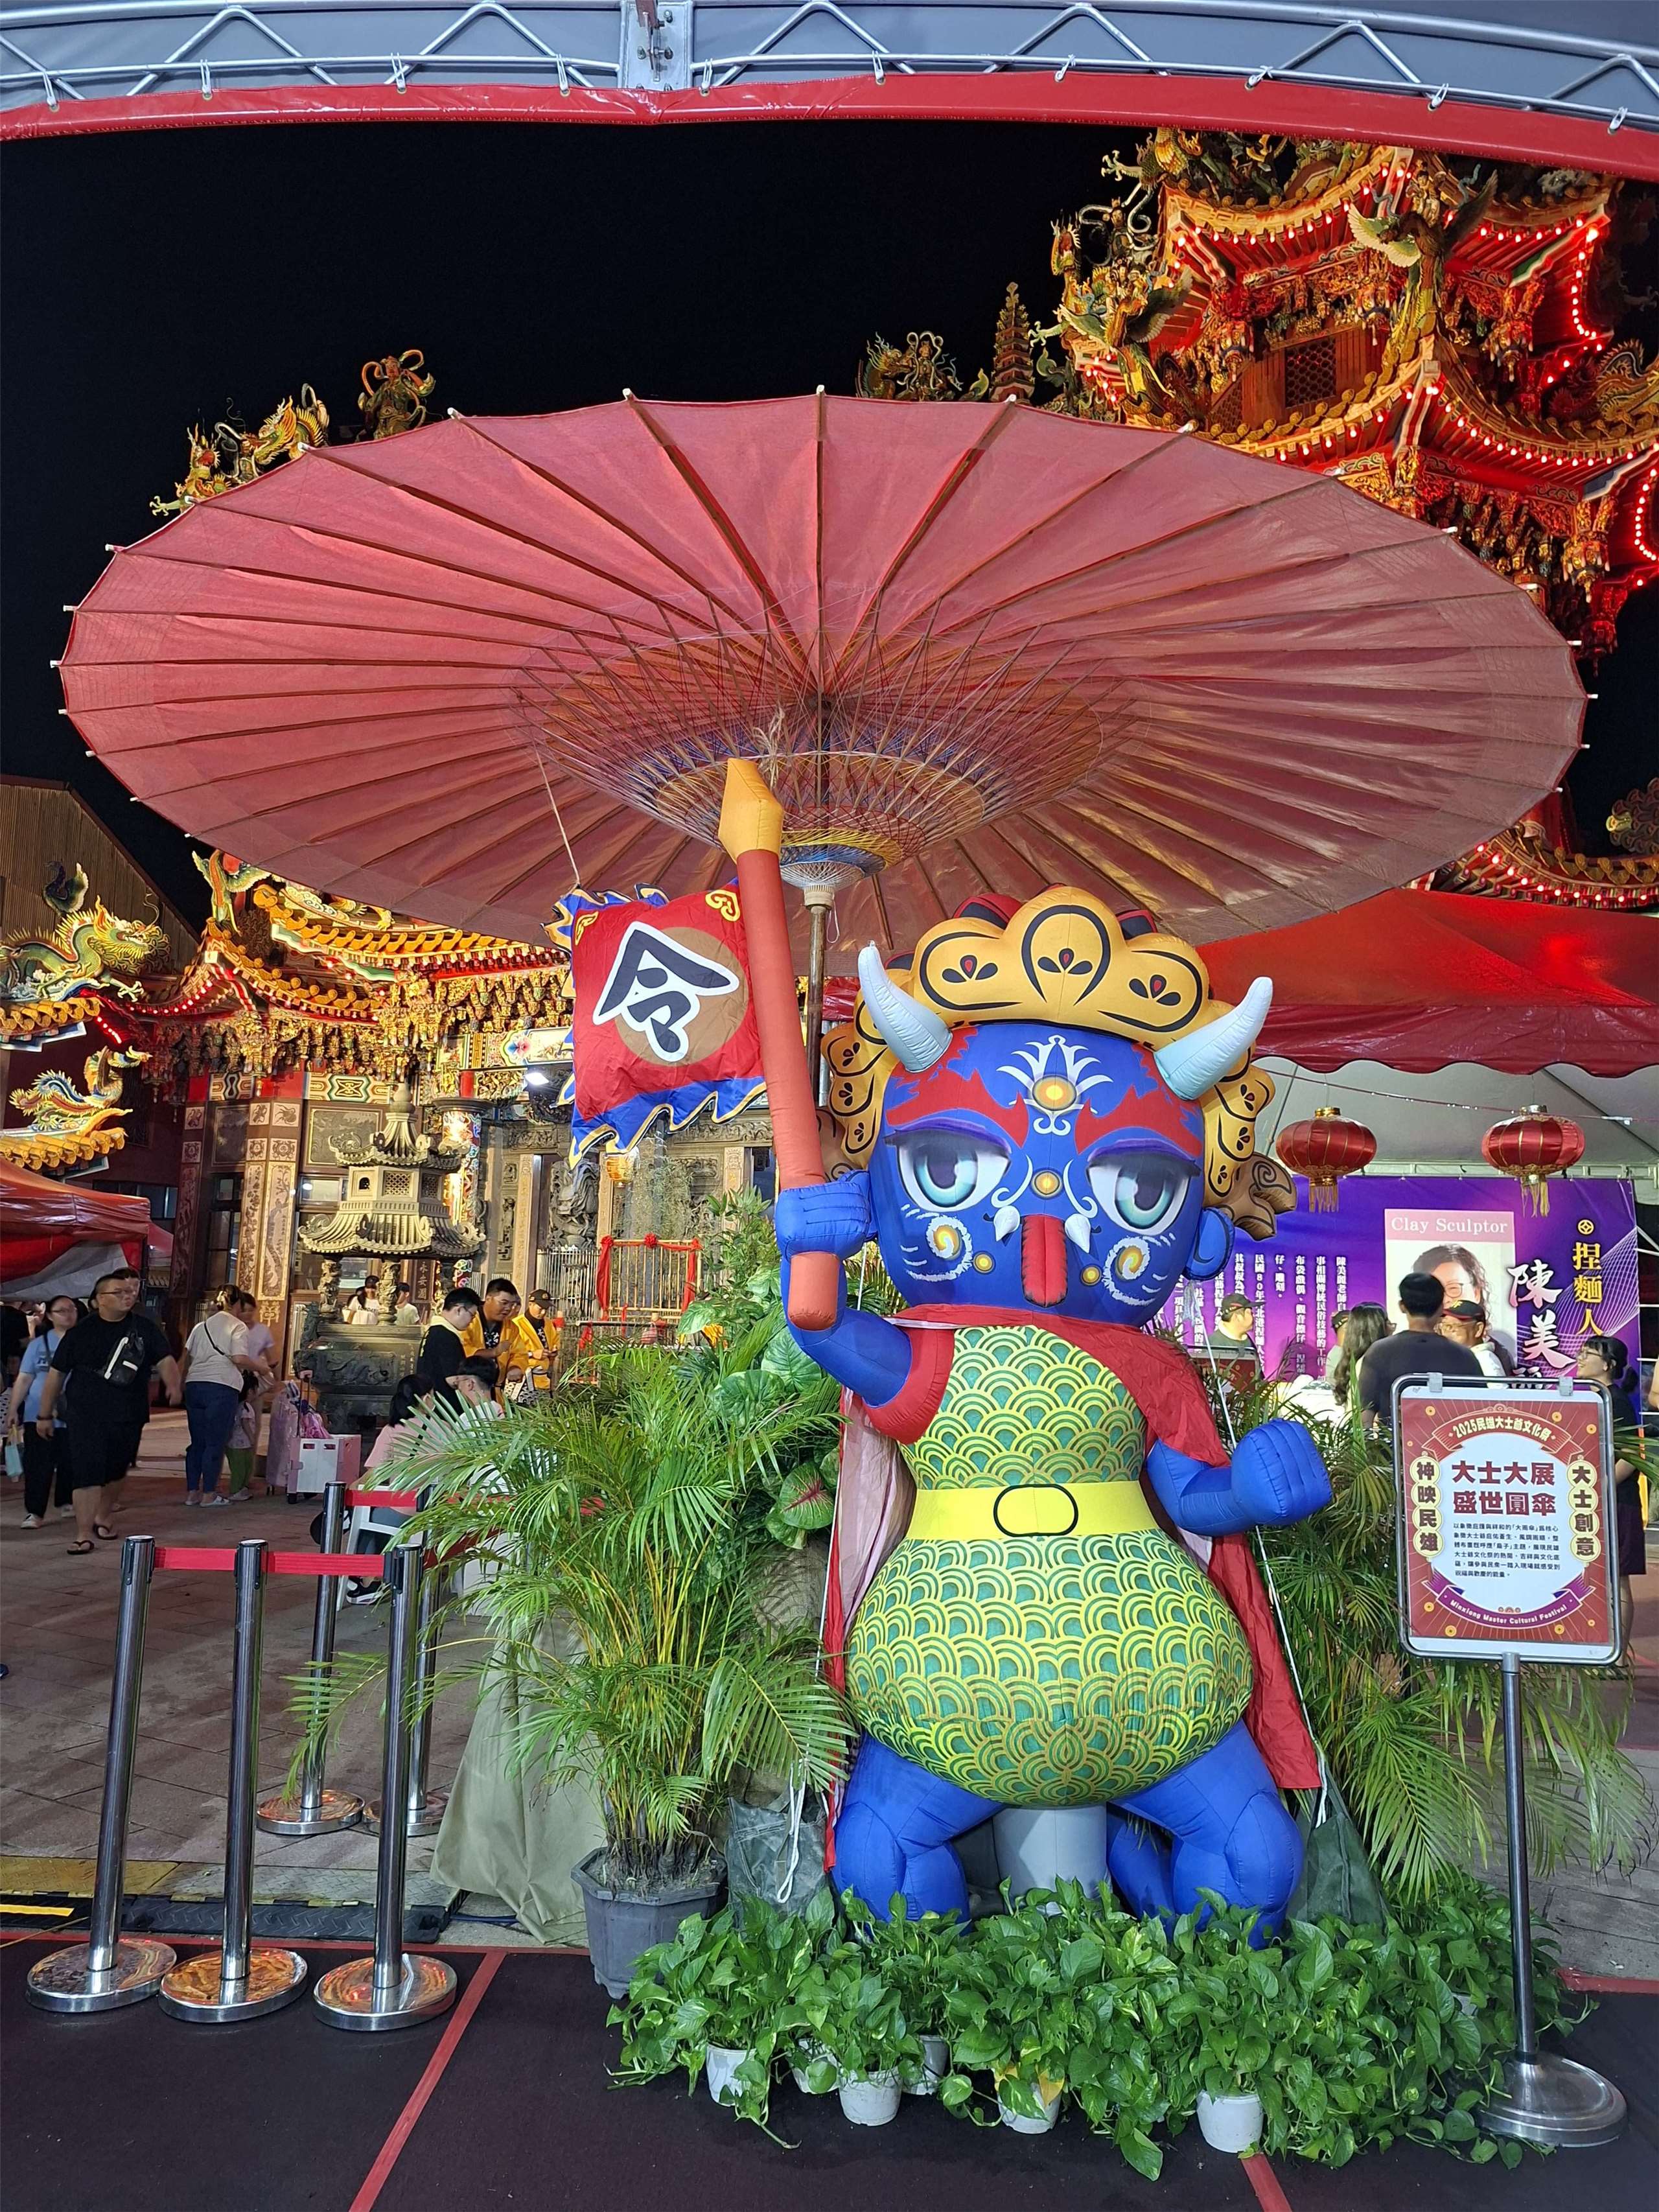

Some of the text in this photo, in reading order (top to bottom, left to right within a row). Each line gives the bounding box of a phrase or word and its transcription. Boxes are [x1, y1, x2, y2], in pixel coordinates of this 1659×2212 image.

[593, 921, 739, 1062] 令
[1391, 1217, 1508, 1235] Clay Sculptor
[1572, 1242, 1603, 1336] 捏麵人
[1453, 1415, 1551, 1441] 2025民雄大士爺文化祭
[1452, 1460, 1555, 1485] 大士大展
[1417, 1461, 1438, 1552] 神映民雄
[1453, 1491, 1556, 1516] 盛世圓傘
[1572, 1465, 1595, 1556] 大士創意
[1450, 1600, 1568, 1624] Minxiong Master Cultural Festival
